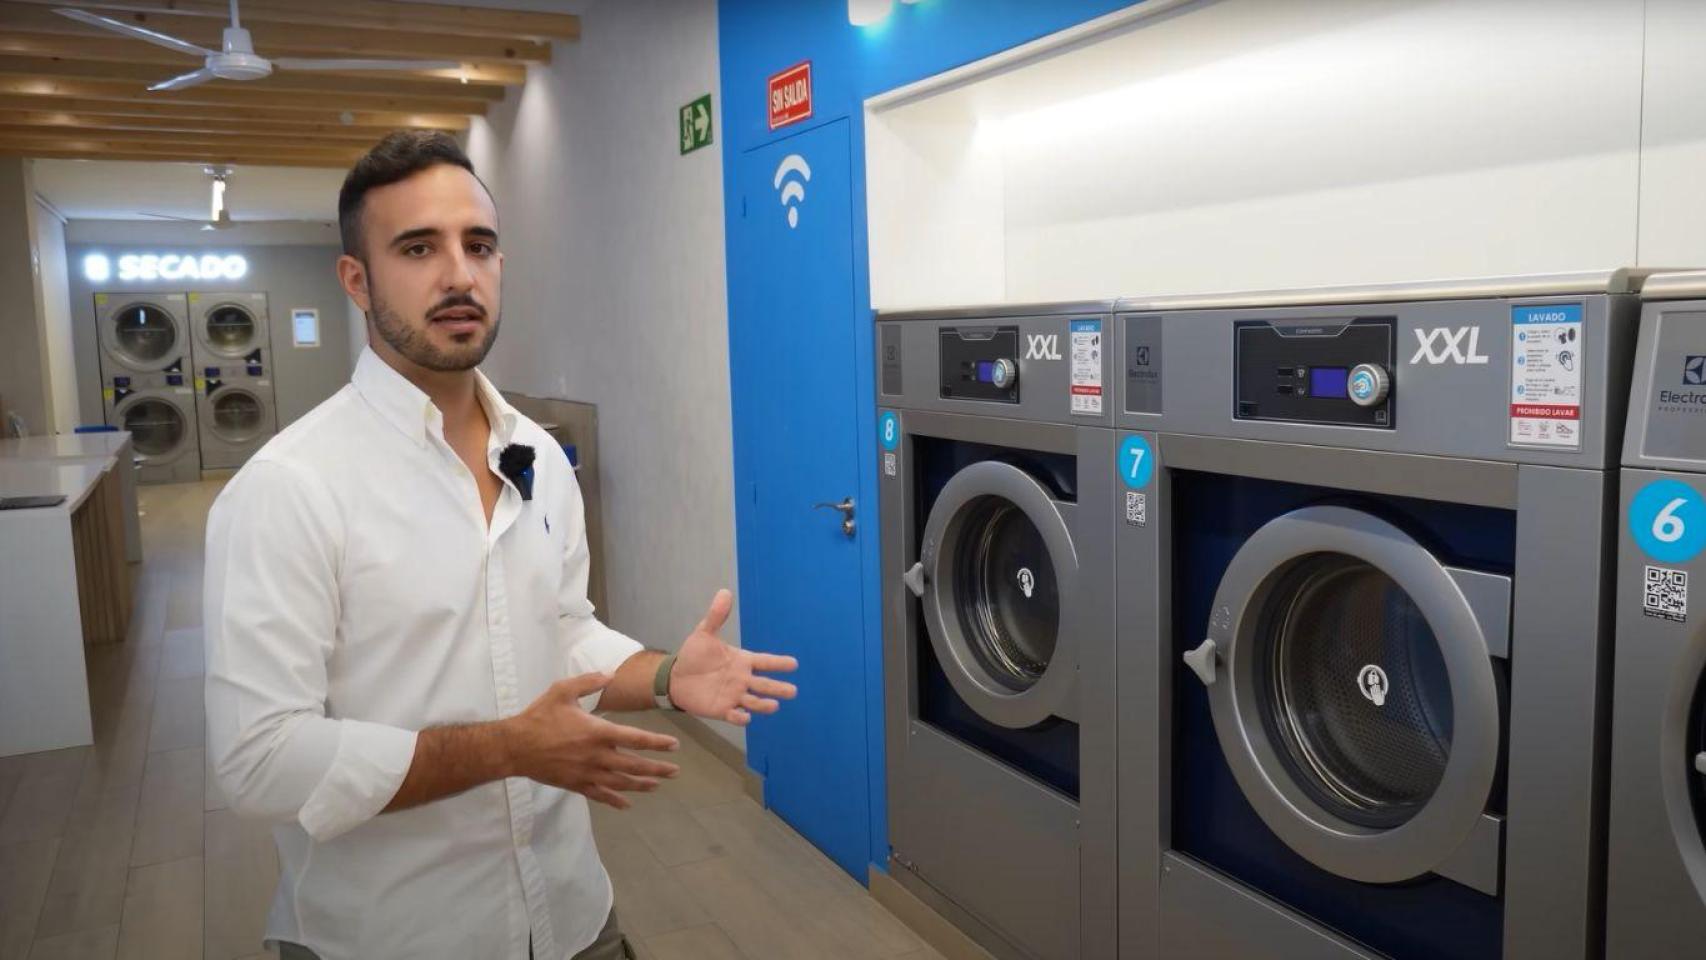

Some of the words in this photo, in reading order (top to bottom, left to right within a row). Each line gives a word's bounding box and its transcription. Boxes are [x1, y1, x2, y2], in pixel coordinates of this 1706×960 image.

[772, 88, 784, 114] SIN
[784, 78, 808, 109] SALIDA
[118, 254, 248, 281] SECADO
[1528, 312, 1567, 322] LAVADO
[1025, 334, 1062, 361] XXL
[1409, 326, 1489, 365] XXL
[1516, 407, 1552, 416] PROHIBIDO
[1552, 408, 1574, 417] LAVAR
[885, 419, 894, 441] 8
[1129, 448, 1145, 479] 7
[1652, 497, 1689, 543] 6
